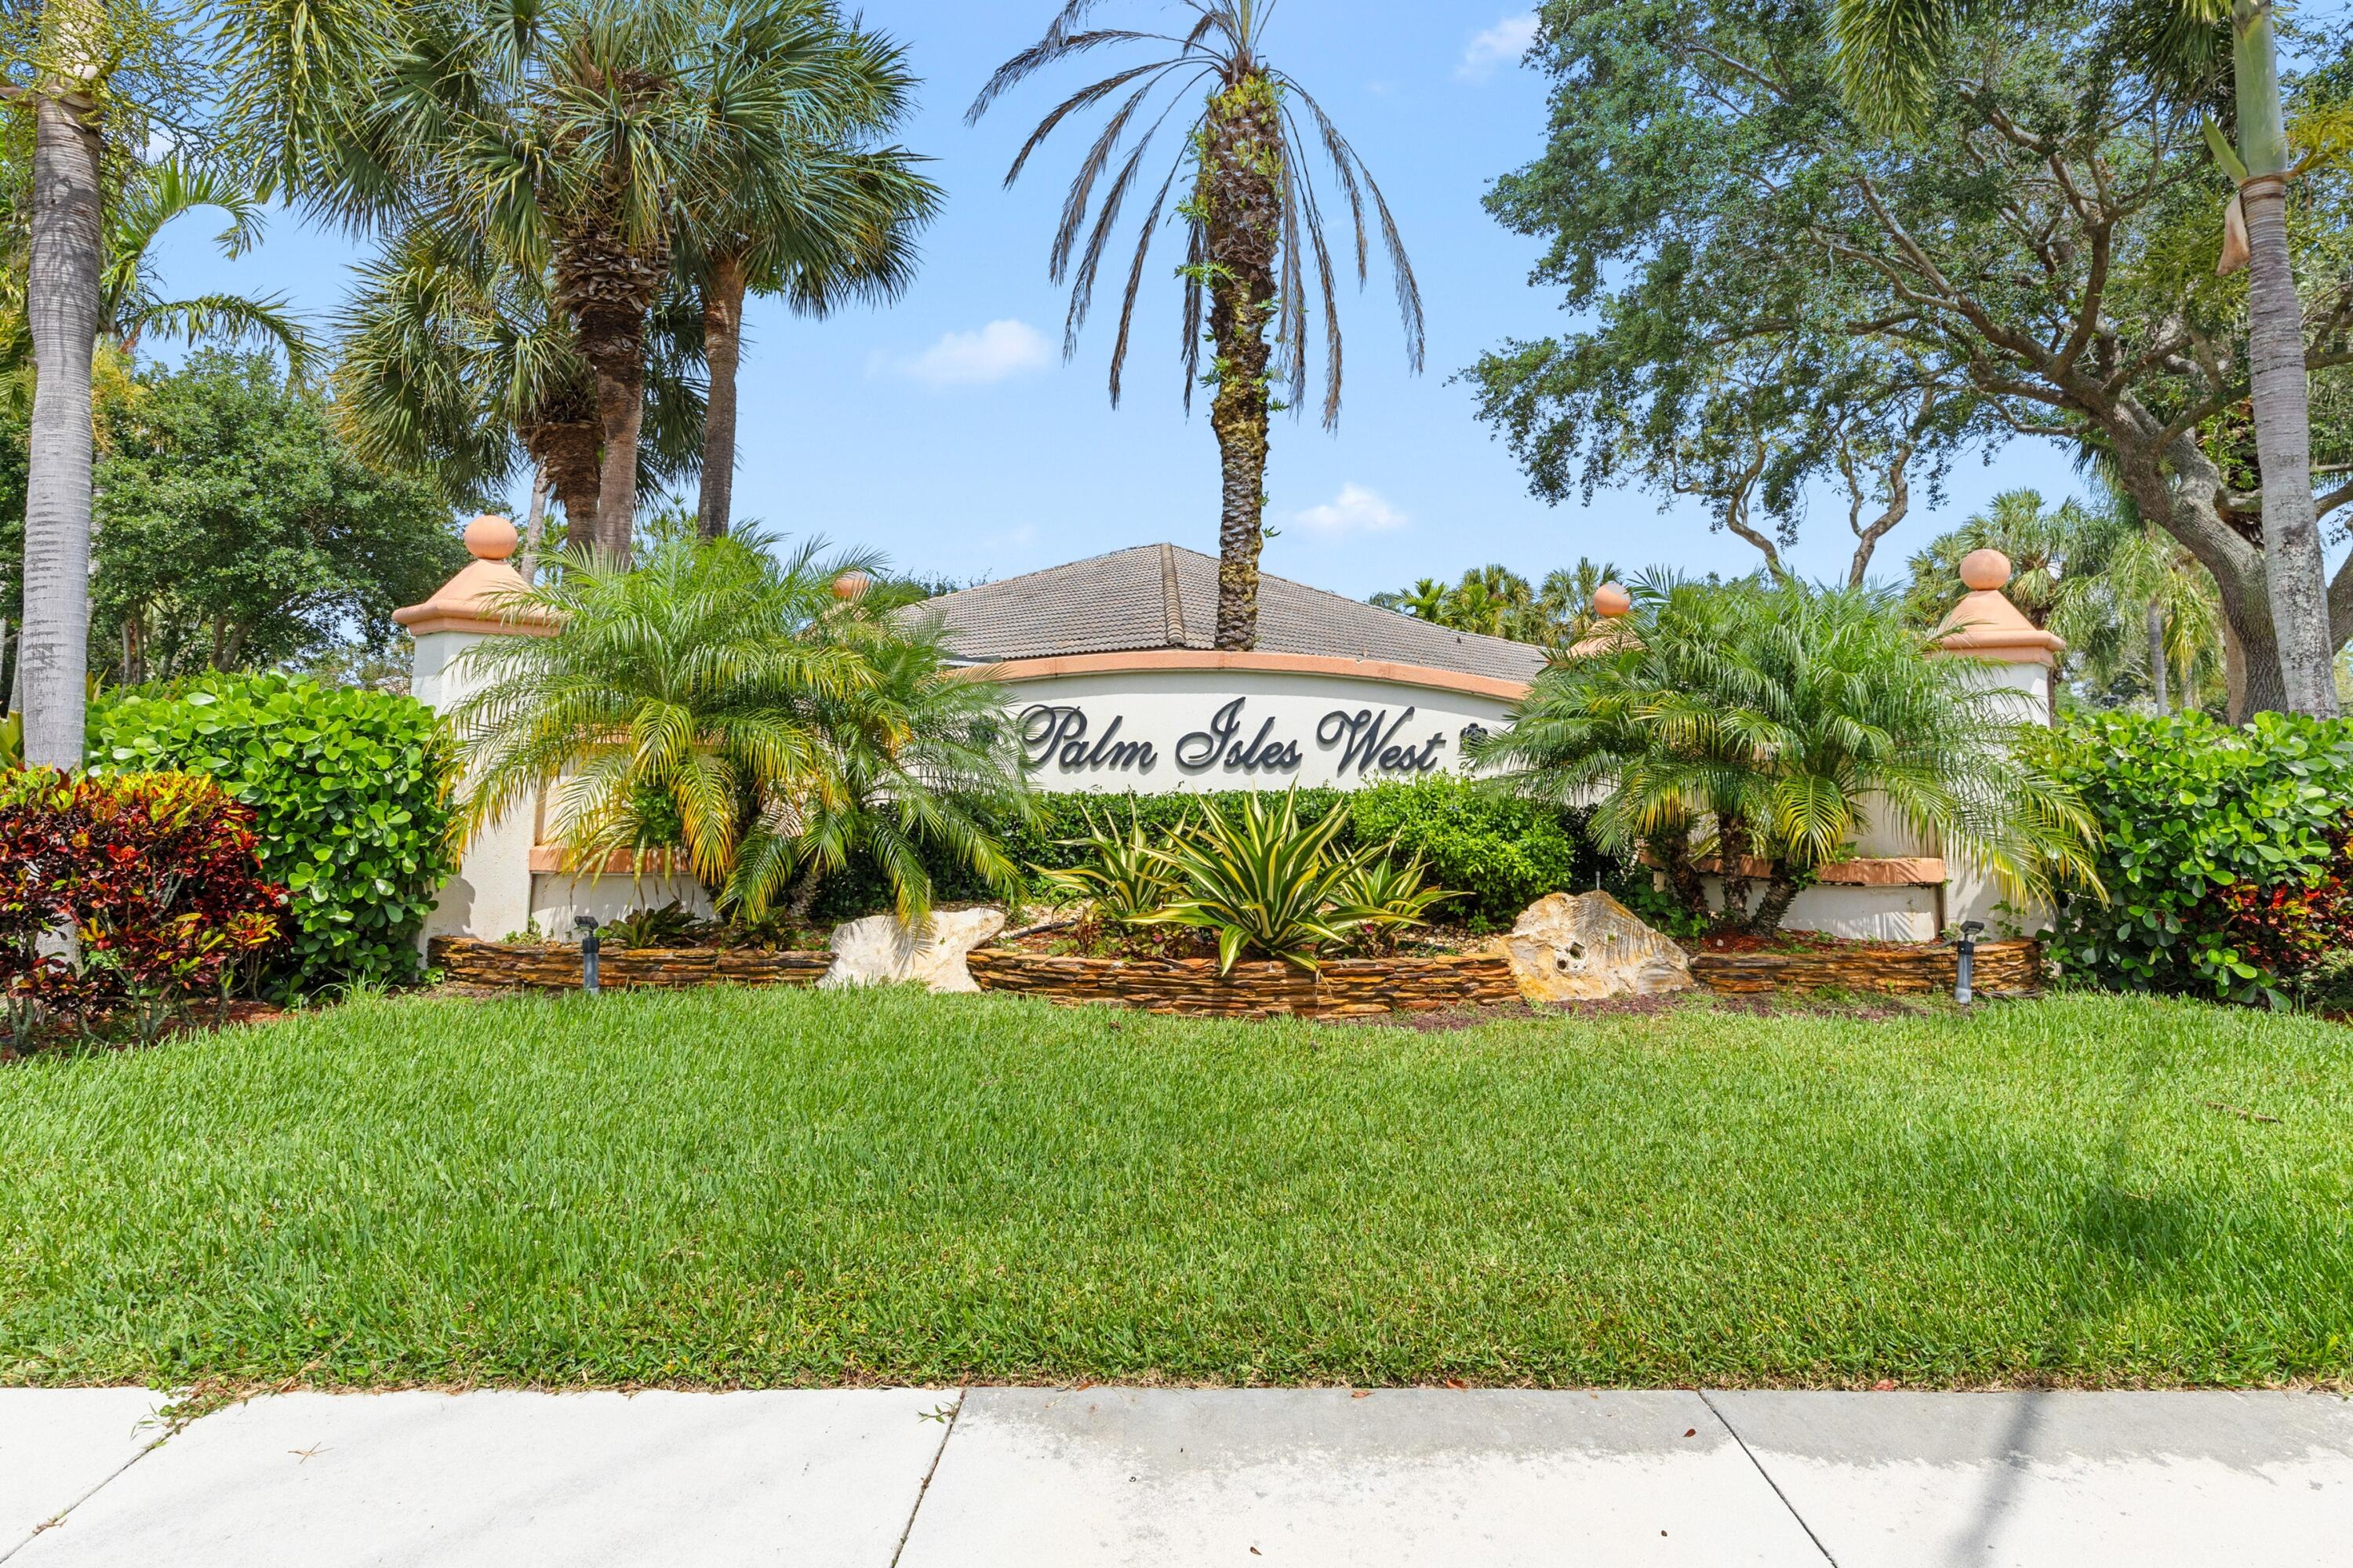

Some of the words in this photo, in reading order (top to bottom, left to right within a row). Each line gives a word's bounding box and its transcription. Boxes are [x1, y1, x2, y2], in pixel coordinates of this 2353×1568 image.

[1020, 704, 1158, 768] Palm
[1176, 697, 1302, 768] Isles
[1316, 706, 1446, 772] West
